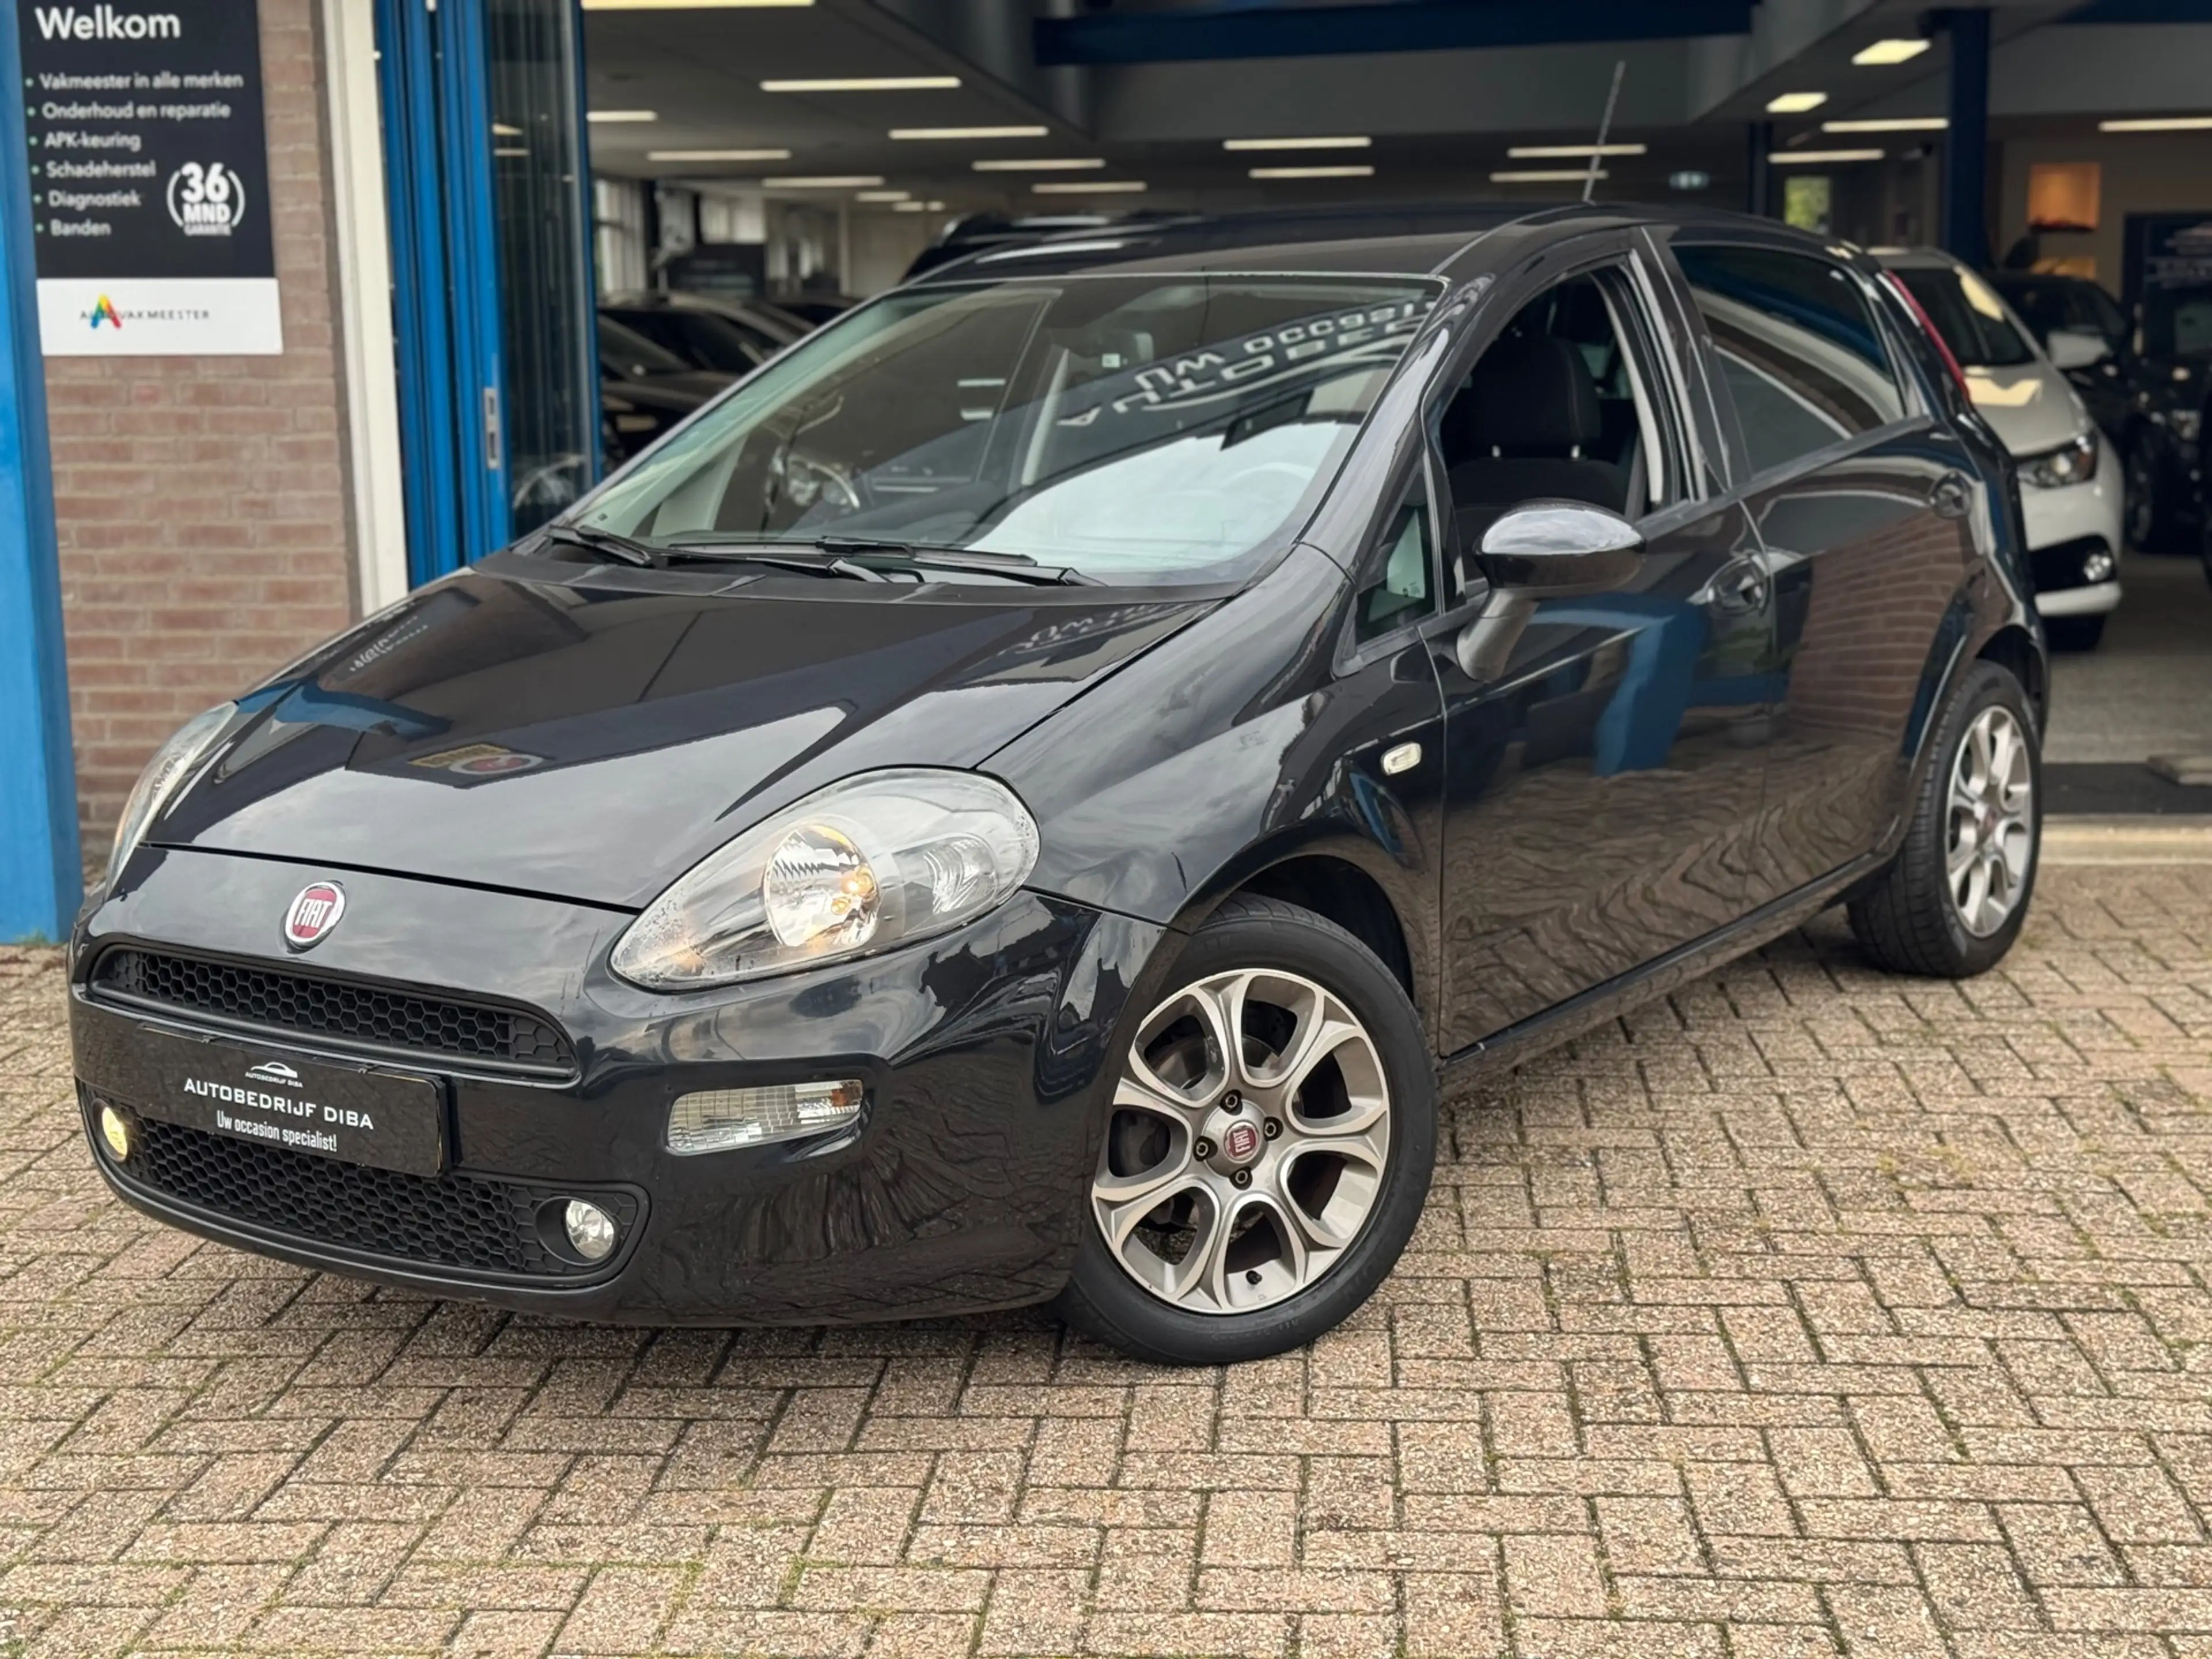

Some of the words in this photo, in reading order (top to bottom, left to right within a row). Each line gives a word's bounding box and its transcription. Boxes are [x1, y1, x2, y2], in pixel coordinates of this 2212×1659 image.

[35, 5, 181, 39] Welkom
[39, 73, 131, 89] Vakmeester
[134, 72, 150, 88] in
[152, 70, 180, 88] alle
[183, 70, 244, 88] merken
[42, 100, 134, 119] Onderhoud
[137, 104, 157, 118] en
[160, 101, 231, 122] reparatie
[44, 131, 142, 153] APK-keuring
[46, 159, 156, 179] Schadeherstel
[181, 162, 230, 203] 36
[48, 188, 141, 211] Diagnostiek
[183, 203, 231, 224] MND
[50, 218, 112, 237] Banden
[294, 898, 333, 929] FIAT
[184, 1078, 317, 1118] AUTOBEDRIJF
[323, 1106, 374, 1130] DIBA
[217, 1109, 232, 1130] Uw
[234, 1119, 280, 1140] occasion
[282, 1128, 338, 1152] specialist!
[1233, 1130, 1251, 1153] FIAT
